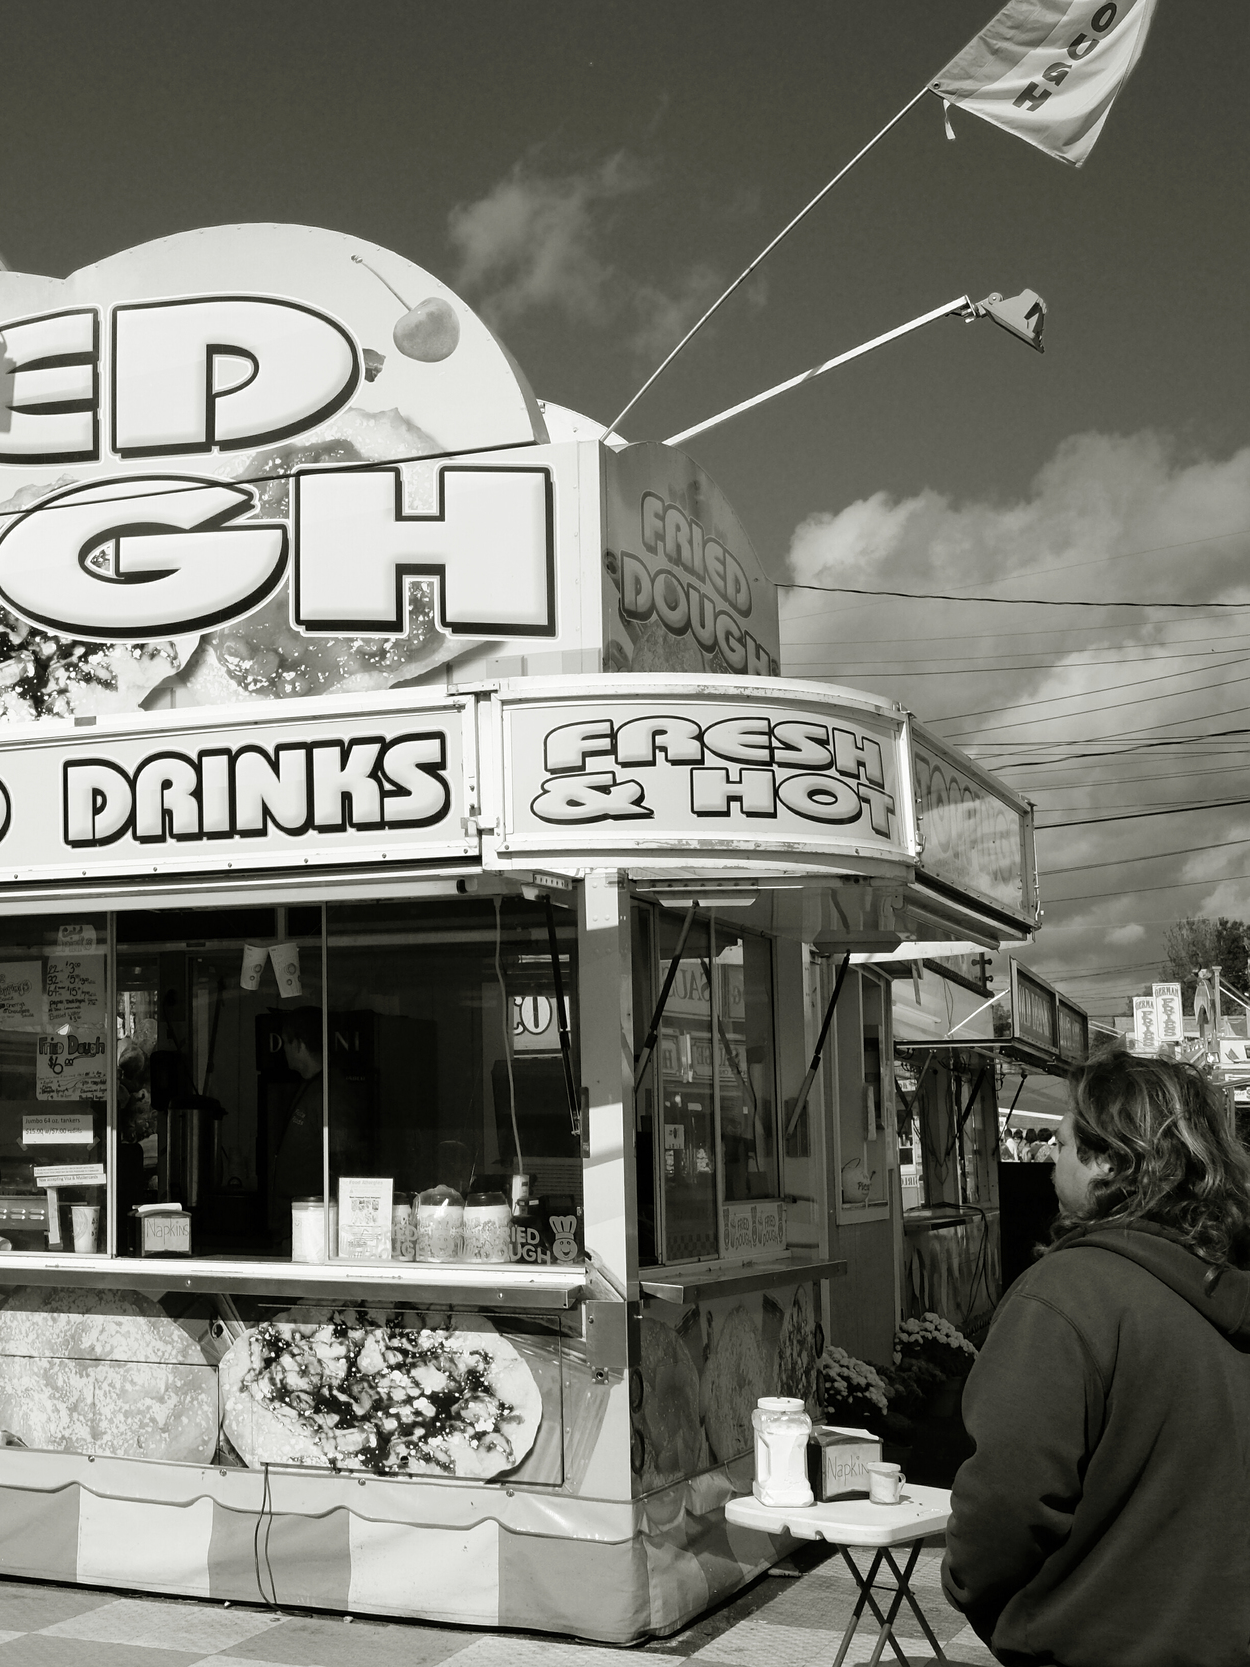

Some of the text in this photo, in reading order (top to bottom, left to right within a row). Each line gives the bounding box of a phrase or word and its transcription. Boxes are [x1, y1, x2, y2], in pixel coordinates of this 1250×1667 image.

[640, 489, 753, 620] FRIED
[618, 549, 772, 676] DOUGH
[62, 730, 448, 850] DRINKS
[543, 714, 886, 790] FRESH
[530, 766, 897, 840] & HOT
[146, 1217, 190, 1246] Napkins
[827, 1454, 870, 1487] Napkin
